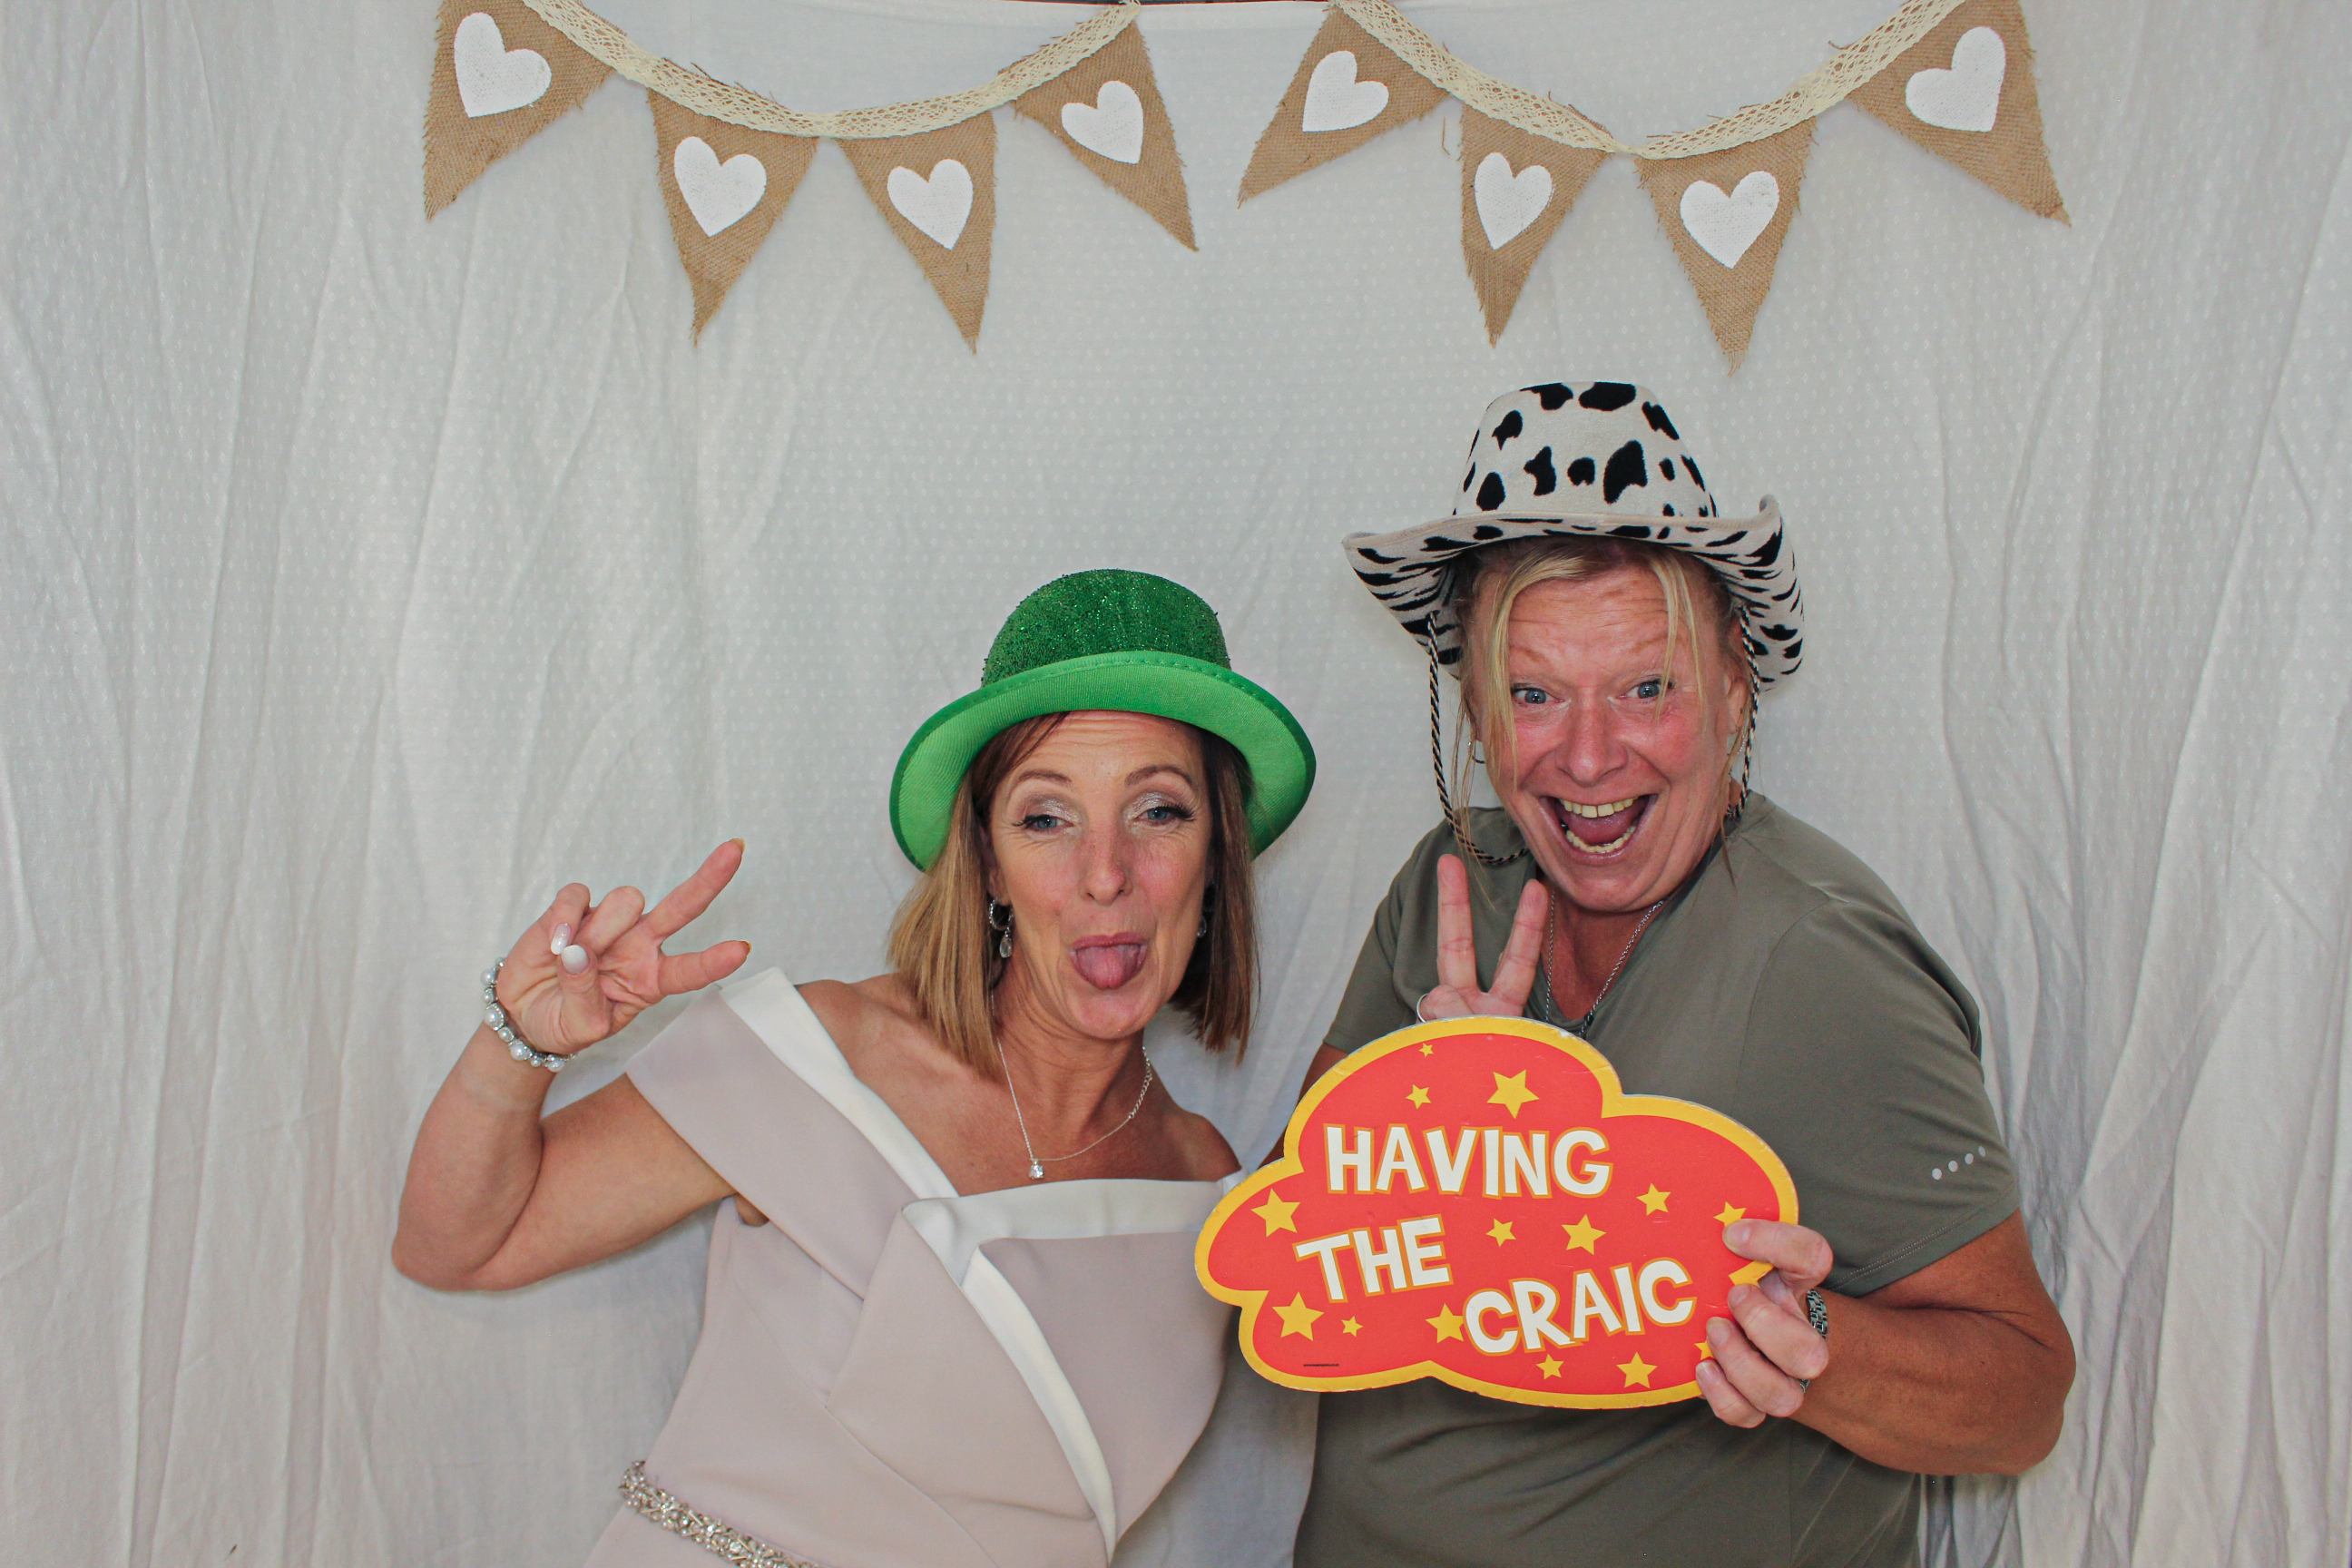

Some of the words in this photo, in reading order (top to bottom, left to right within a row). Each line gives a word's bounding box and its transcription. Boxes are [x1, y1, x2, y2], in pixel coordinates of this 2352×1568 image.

[1324, 1125, 1612, 1199] HAVING
[1295, 1215, 1453, 1301] THE
[1464, 1259, 1695, 1355] CRAIC
